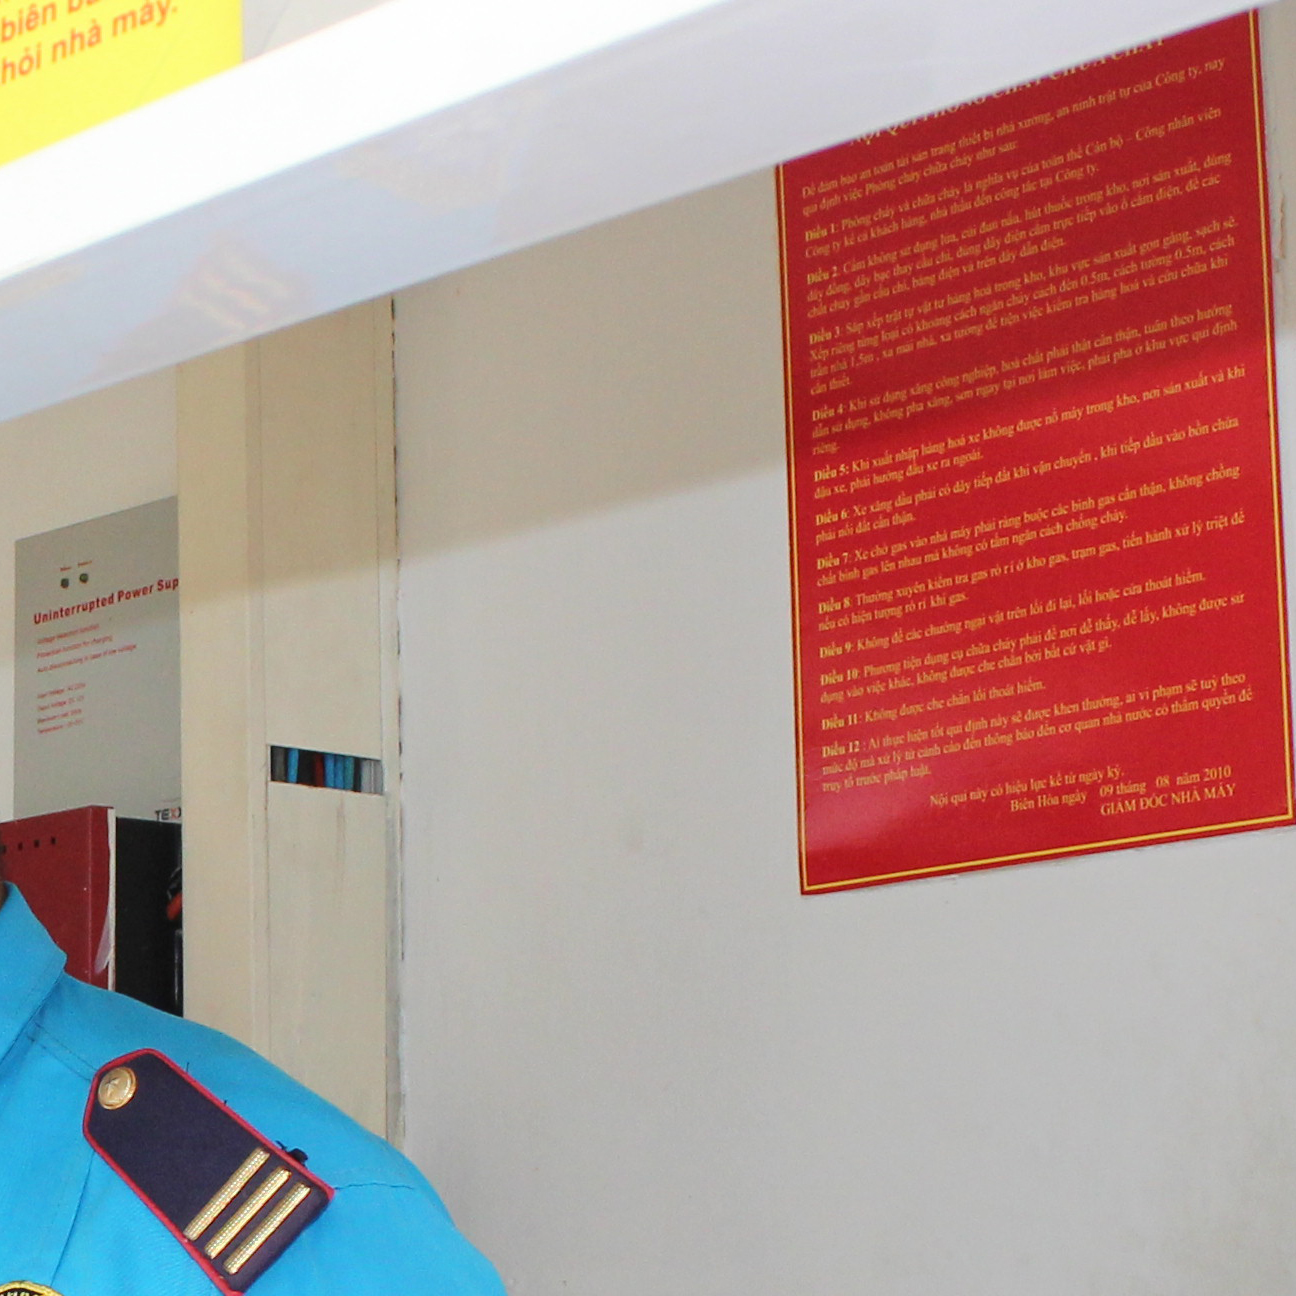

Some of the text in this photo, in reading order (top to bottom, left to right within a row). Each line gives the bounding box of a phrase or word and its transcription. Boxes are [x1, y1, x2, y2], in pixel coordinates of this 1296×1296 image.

[1, 2, 57, 43] biên
[52, 18, 103, 63] nhà
[34, 577, 179, 625] Uninterrupted Power Sup
